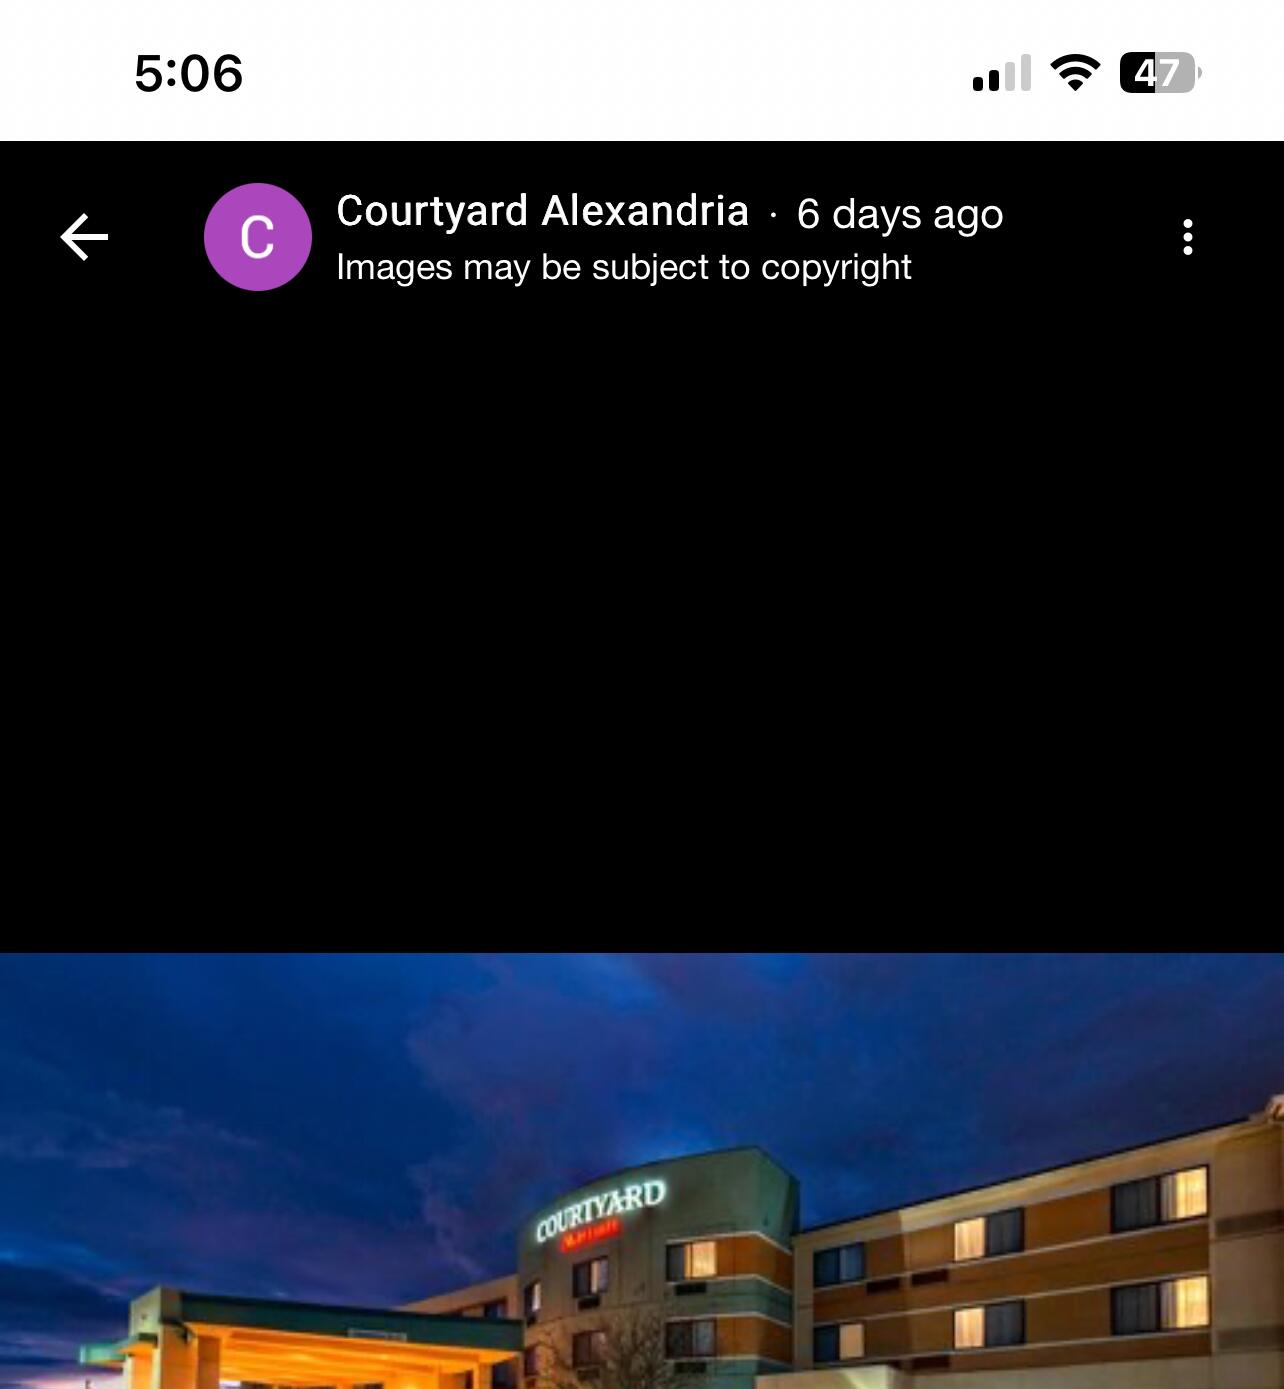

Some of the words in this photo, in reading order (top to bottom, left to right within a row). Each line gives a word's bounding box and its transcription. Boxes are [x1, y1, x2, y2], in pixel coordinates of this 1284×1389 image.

[135, 54, 243, 93] 5:06
[1134, 58, 1180, 87] 47
[337, 193, 527, 235] Courtyard
[541, 193, 749, 227] Alexandria
[798, 198, 820, 230] 6
[832, 197, 922, 237] days
[933, 206, 1004, 237] ago
[241, 215, 274, 260] C
[338, 253, 453, 288] Images
[464, 259, 531, 288] may
[542, 252, 581, 280] be
[592, 252, 709, 287] subject
[718, 255, 750, 280] to
[761, 252, 912, 288] copyright
[536, 1180, 666, 1243] COURTYARD
